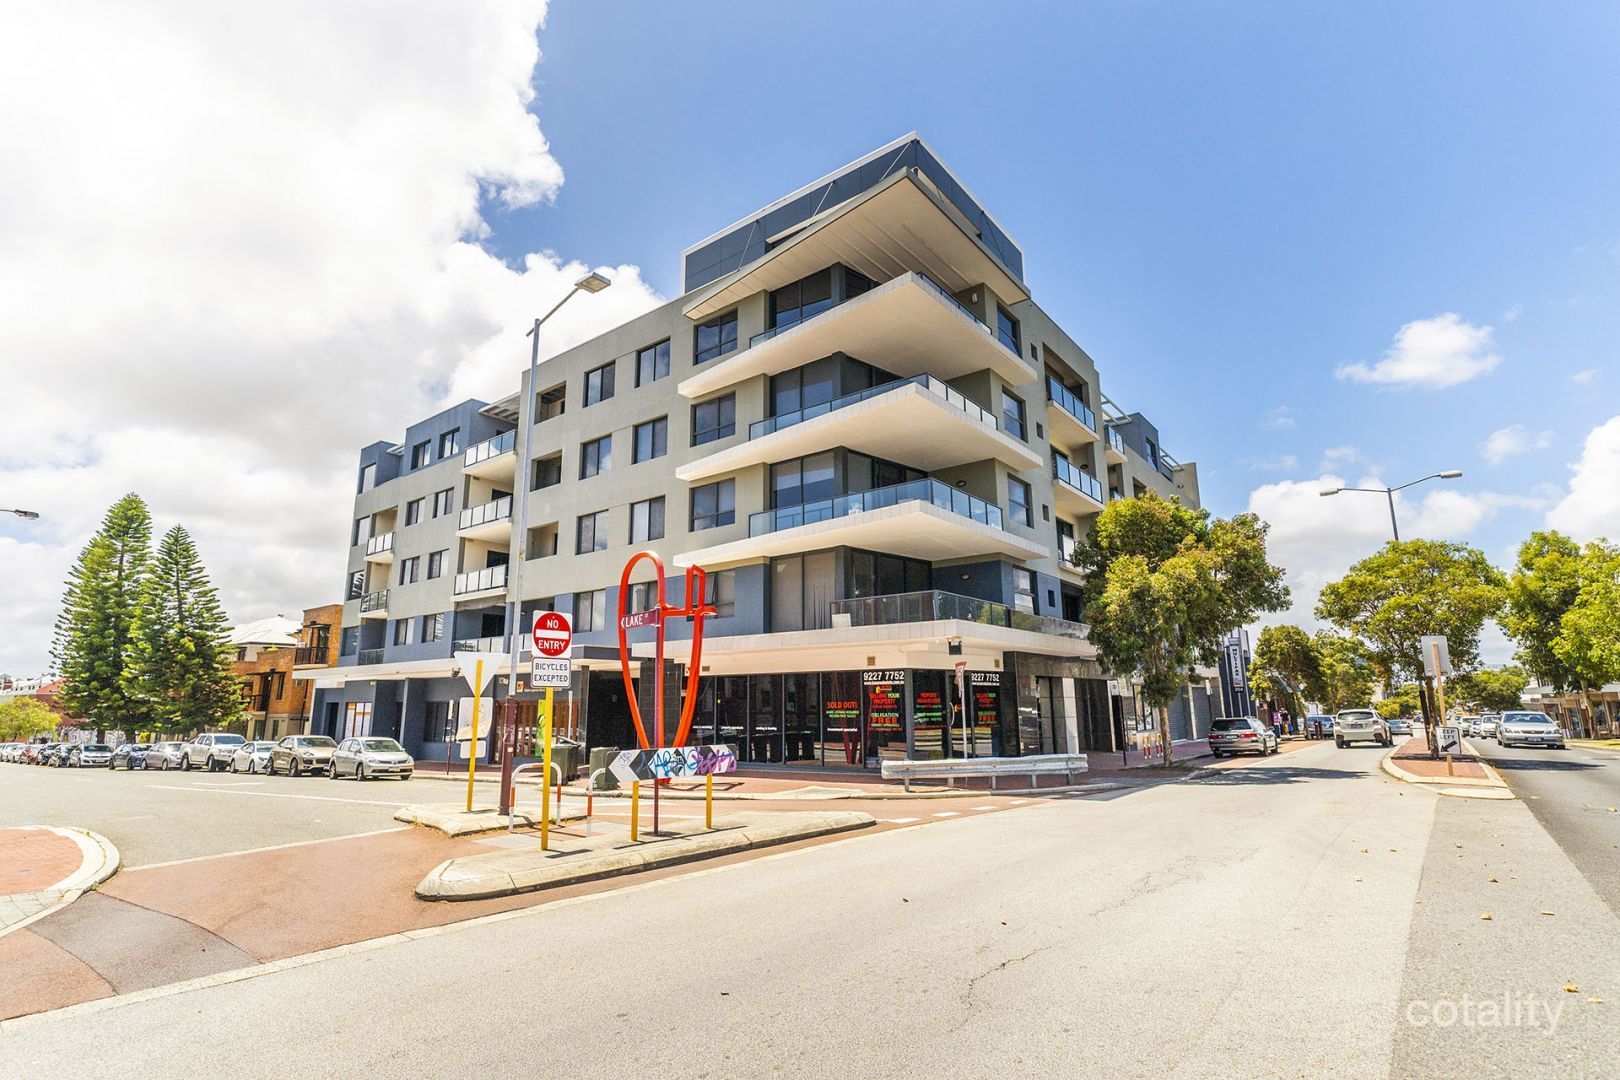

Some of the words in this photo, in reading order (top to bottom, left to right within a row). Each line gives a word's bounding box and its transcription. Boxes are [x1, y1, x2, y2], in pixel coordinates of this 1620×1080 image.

[546, 619, 559, 629] NO
[625, 613, 644, 628] LAKE
[538, 639, 566, 650] ENTRY
[535, 662, 568, 671] BICYCLES
[534, 674, 569, 682] EXCEPTED
[863, 671, 882, 681] 9227
[885, 670, 905, 680] 7752
[985, 673, 1000, 682] 7752
[827, 701, 842, 709] SOLD
[843, 701, 858, 709] OUT!
[871, 716, 897, 724] FREE
